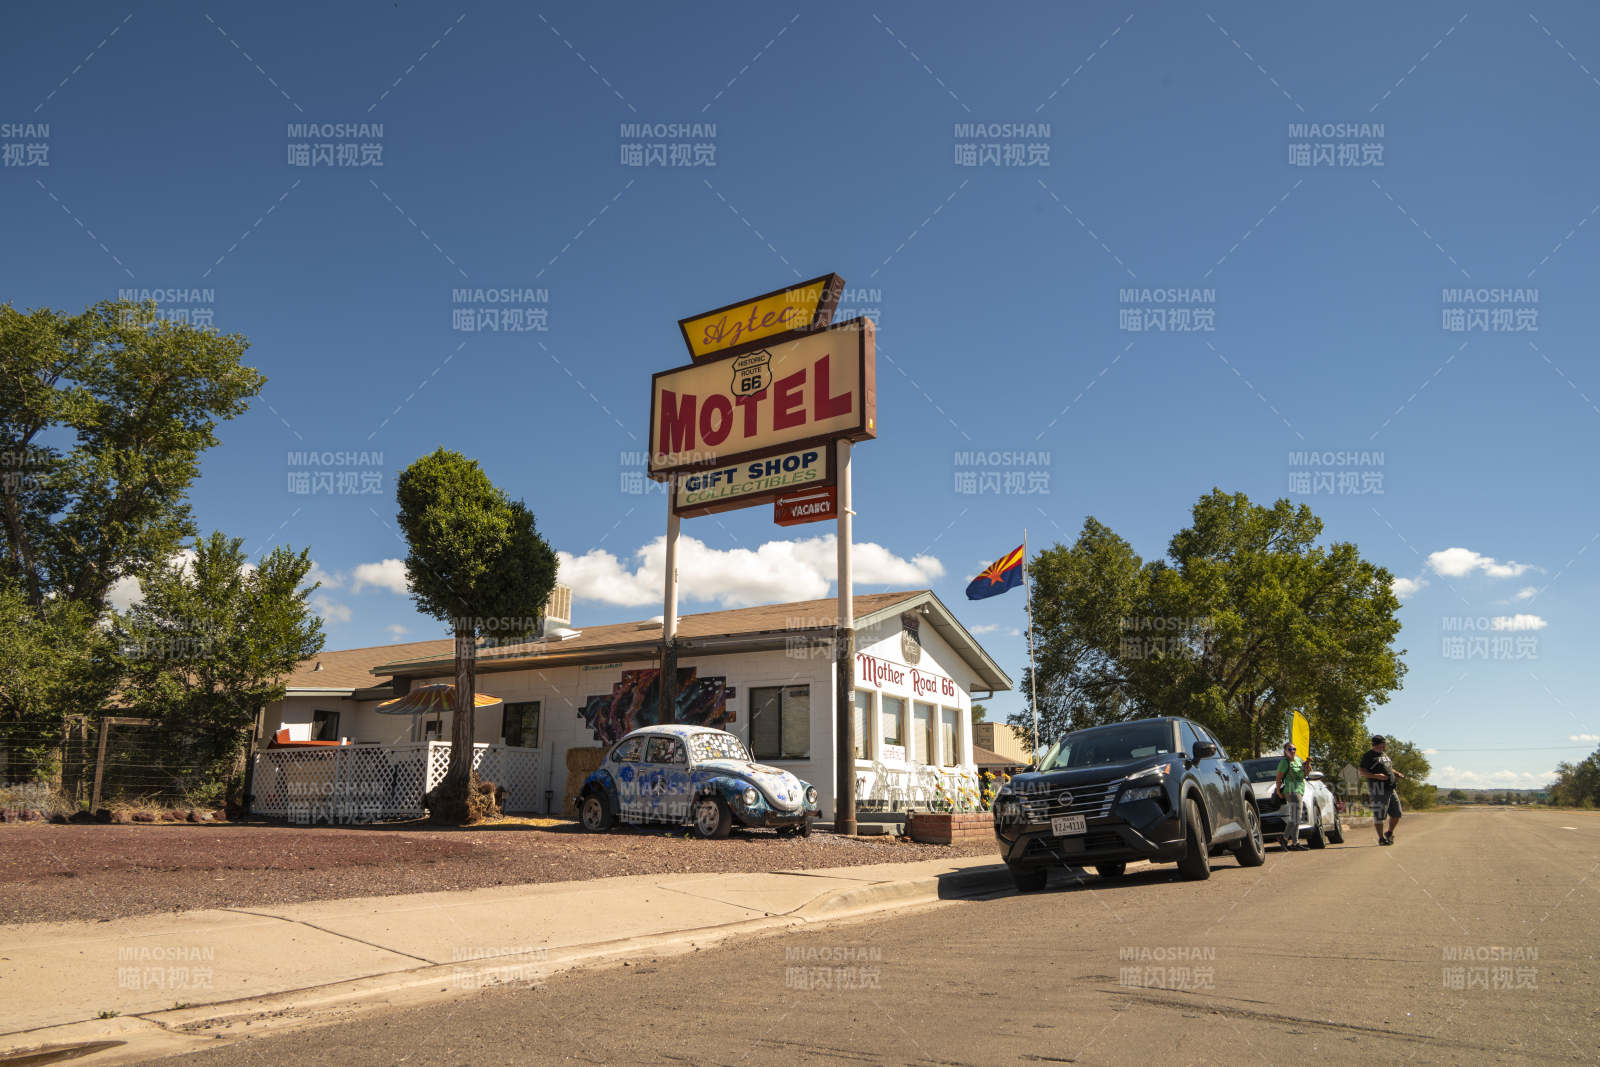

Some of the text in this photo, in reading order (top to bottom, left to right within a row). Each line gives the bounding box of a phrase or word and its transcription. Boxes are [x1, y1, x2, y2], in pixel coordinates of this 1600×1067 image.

[703, 306, 802, 348] Aztec
[738, 355, 766, 367] HISTORIC
[741, 367, 761, 377] ROUTE
[742, 375, 761, 392] 66
[659, 353, 853, 457] MOTEL
[686, 451, 818, 492] GIFT SHOP
[686, 469, 817, 503] COLLECTIBLES
[792, 500, 831, 517] VACANCY
[856, 653, 955, 696] Mother Road 66
